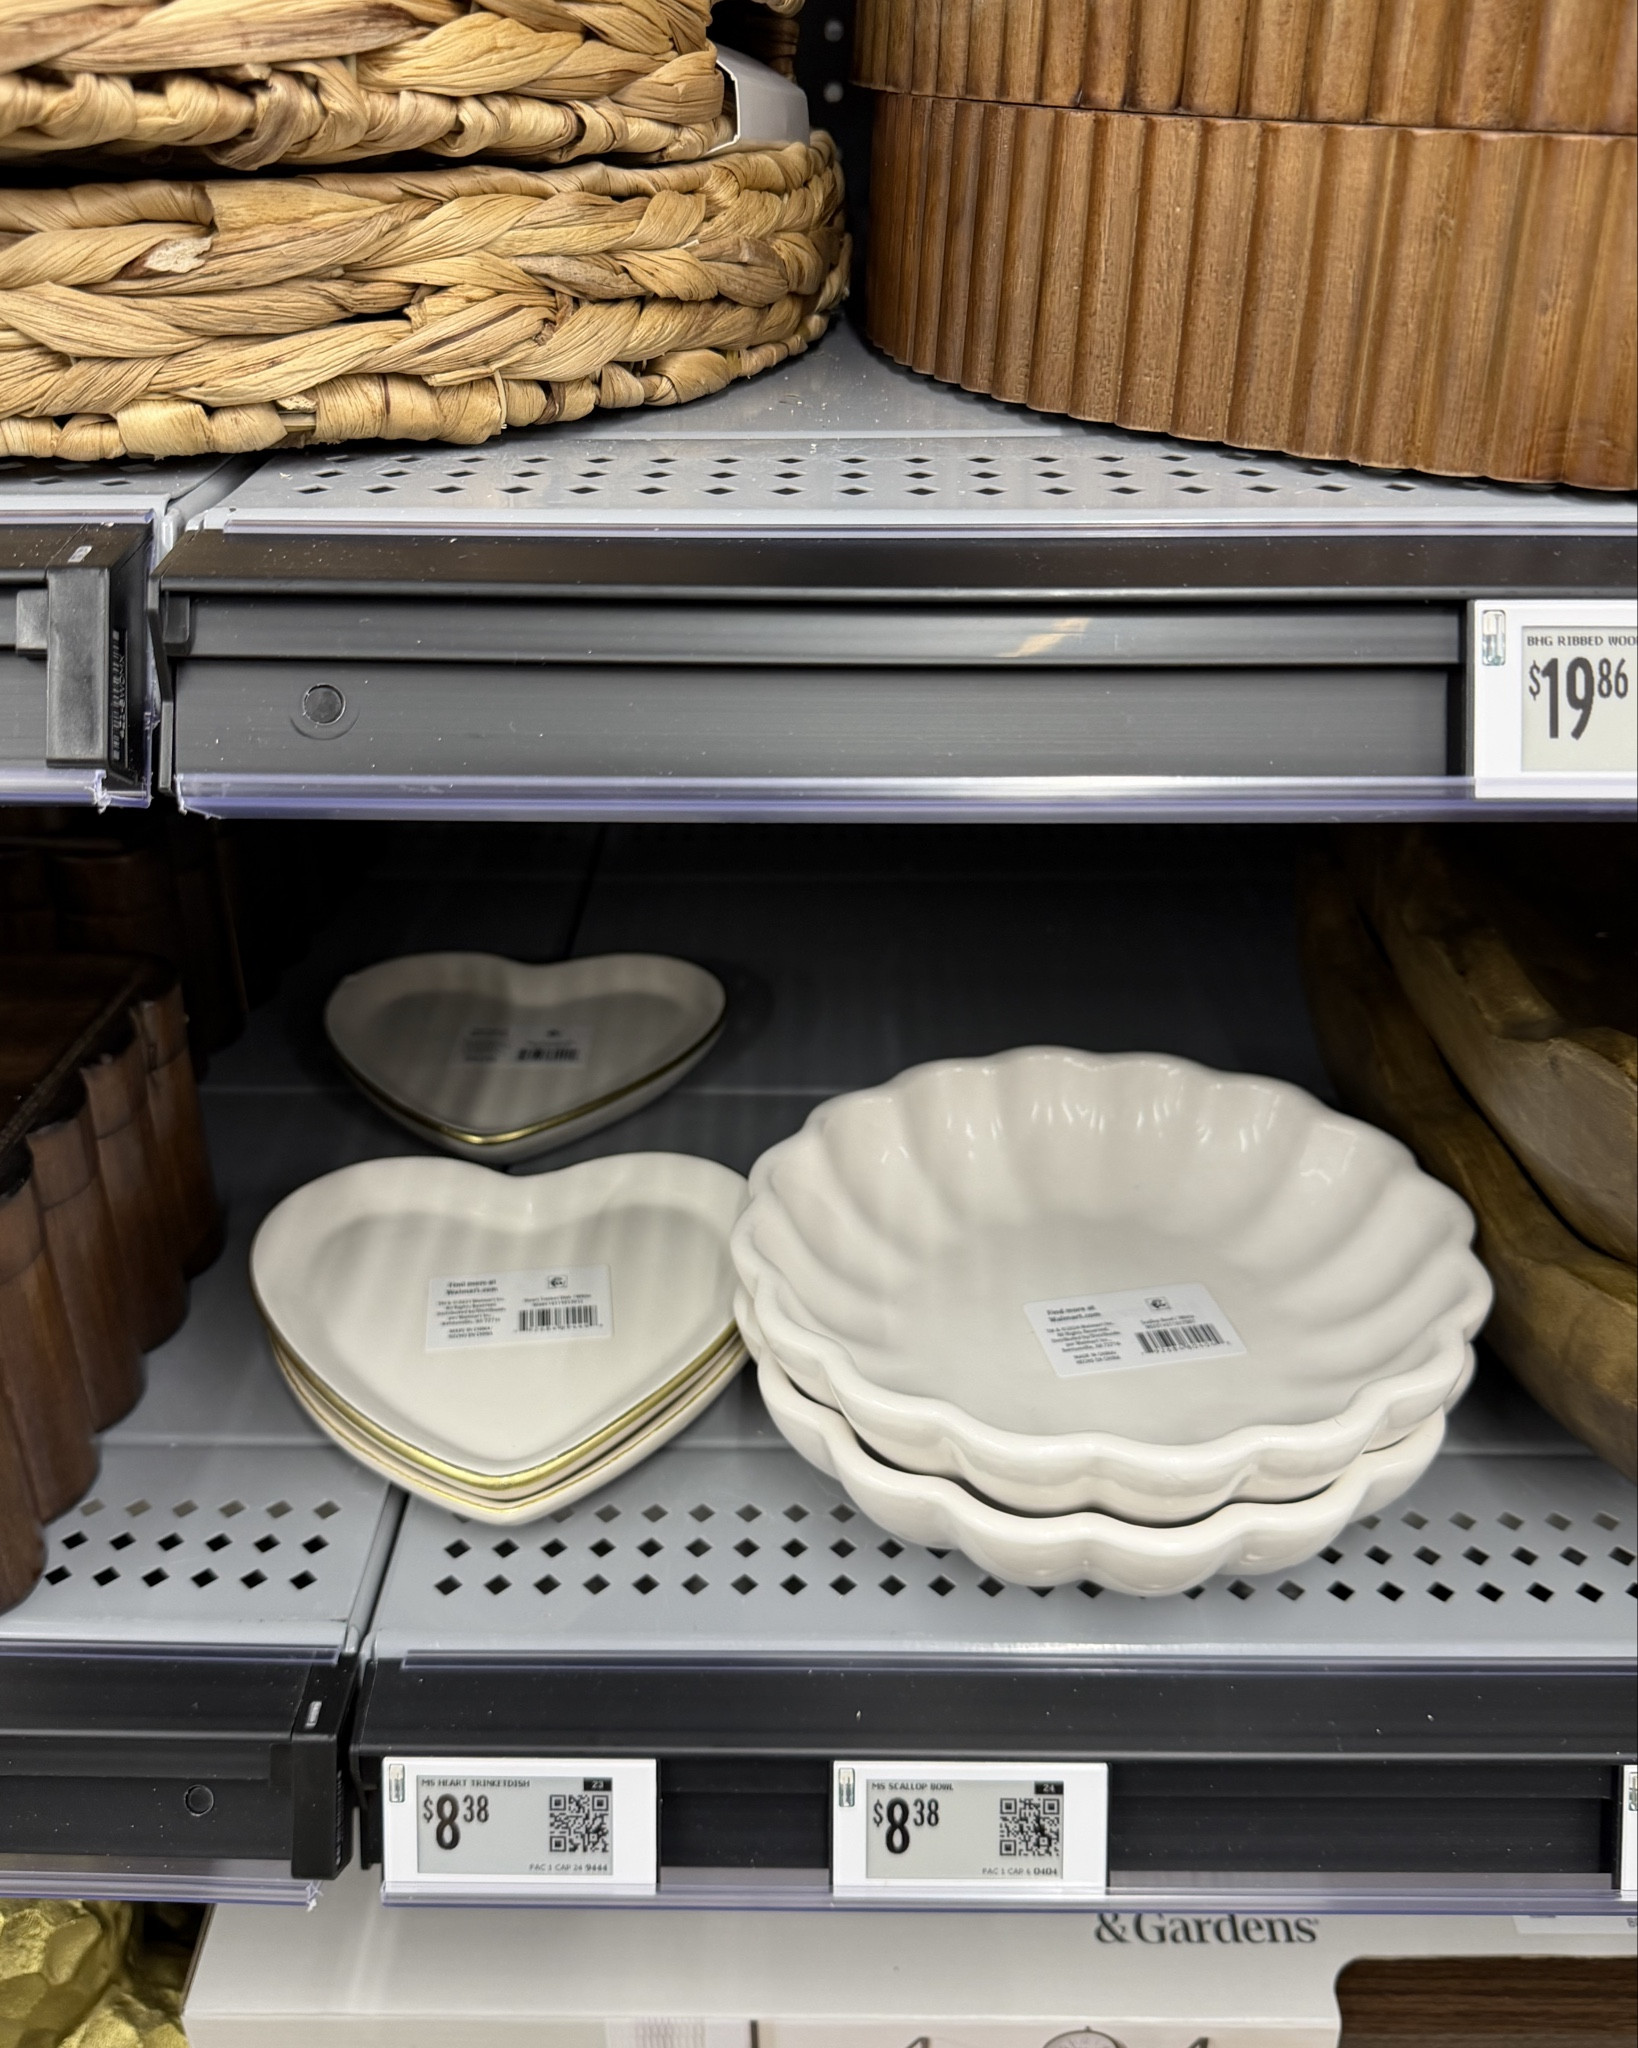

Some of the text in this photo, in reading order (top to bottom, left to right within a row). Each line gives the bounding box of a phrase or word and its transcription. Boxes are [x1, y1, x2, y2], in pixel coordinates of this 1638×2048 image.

[1527, 635, 1638, 646] BHG RIBBED WOO
[438, 1778, 467, 1787] HEART
[888, 1782, 928, 1791] SCALLOP
[930, 1782, 954, 1791] BOWL
